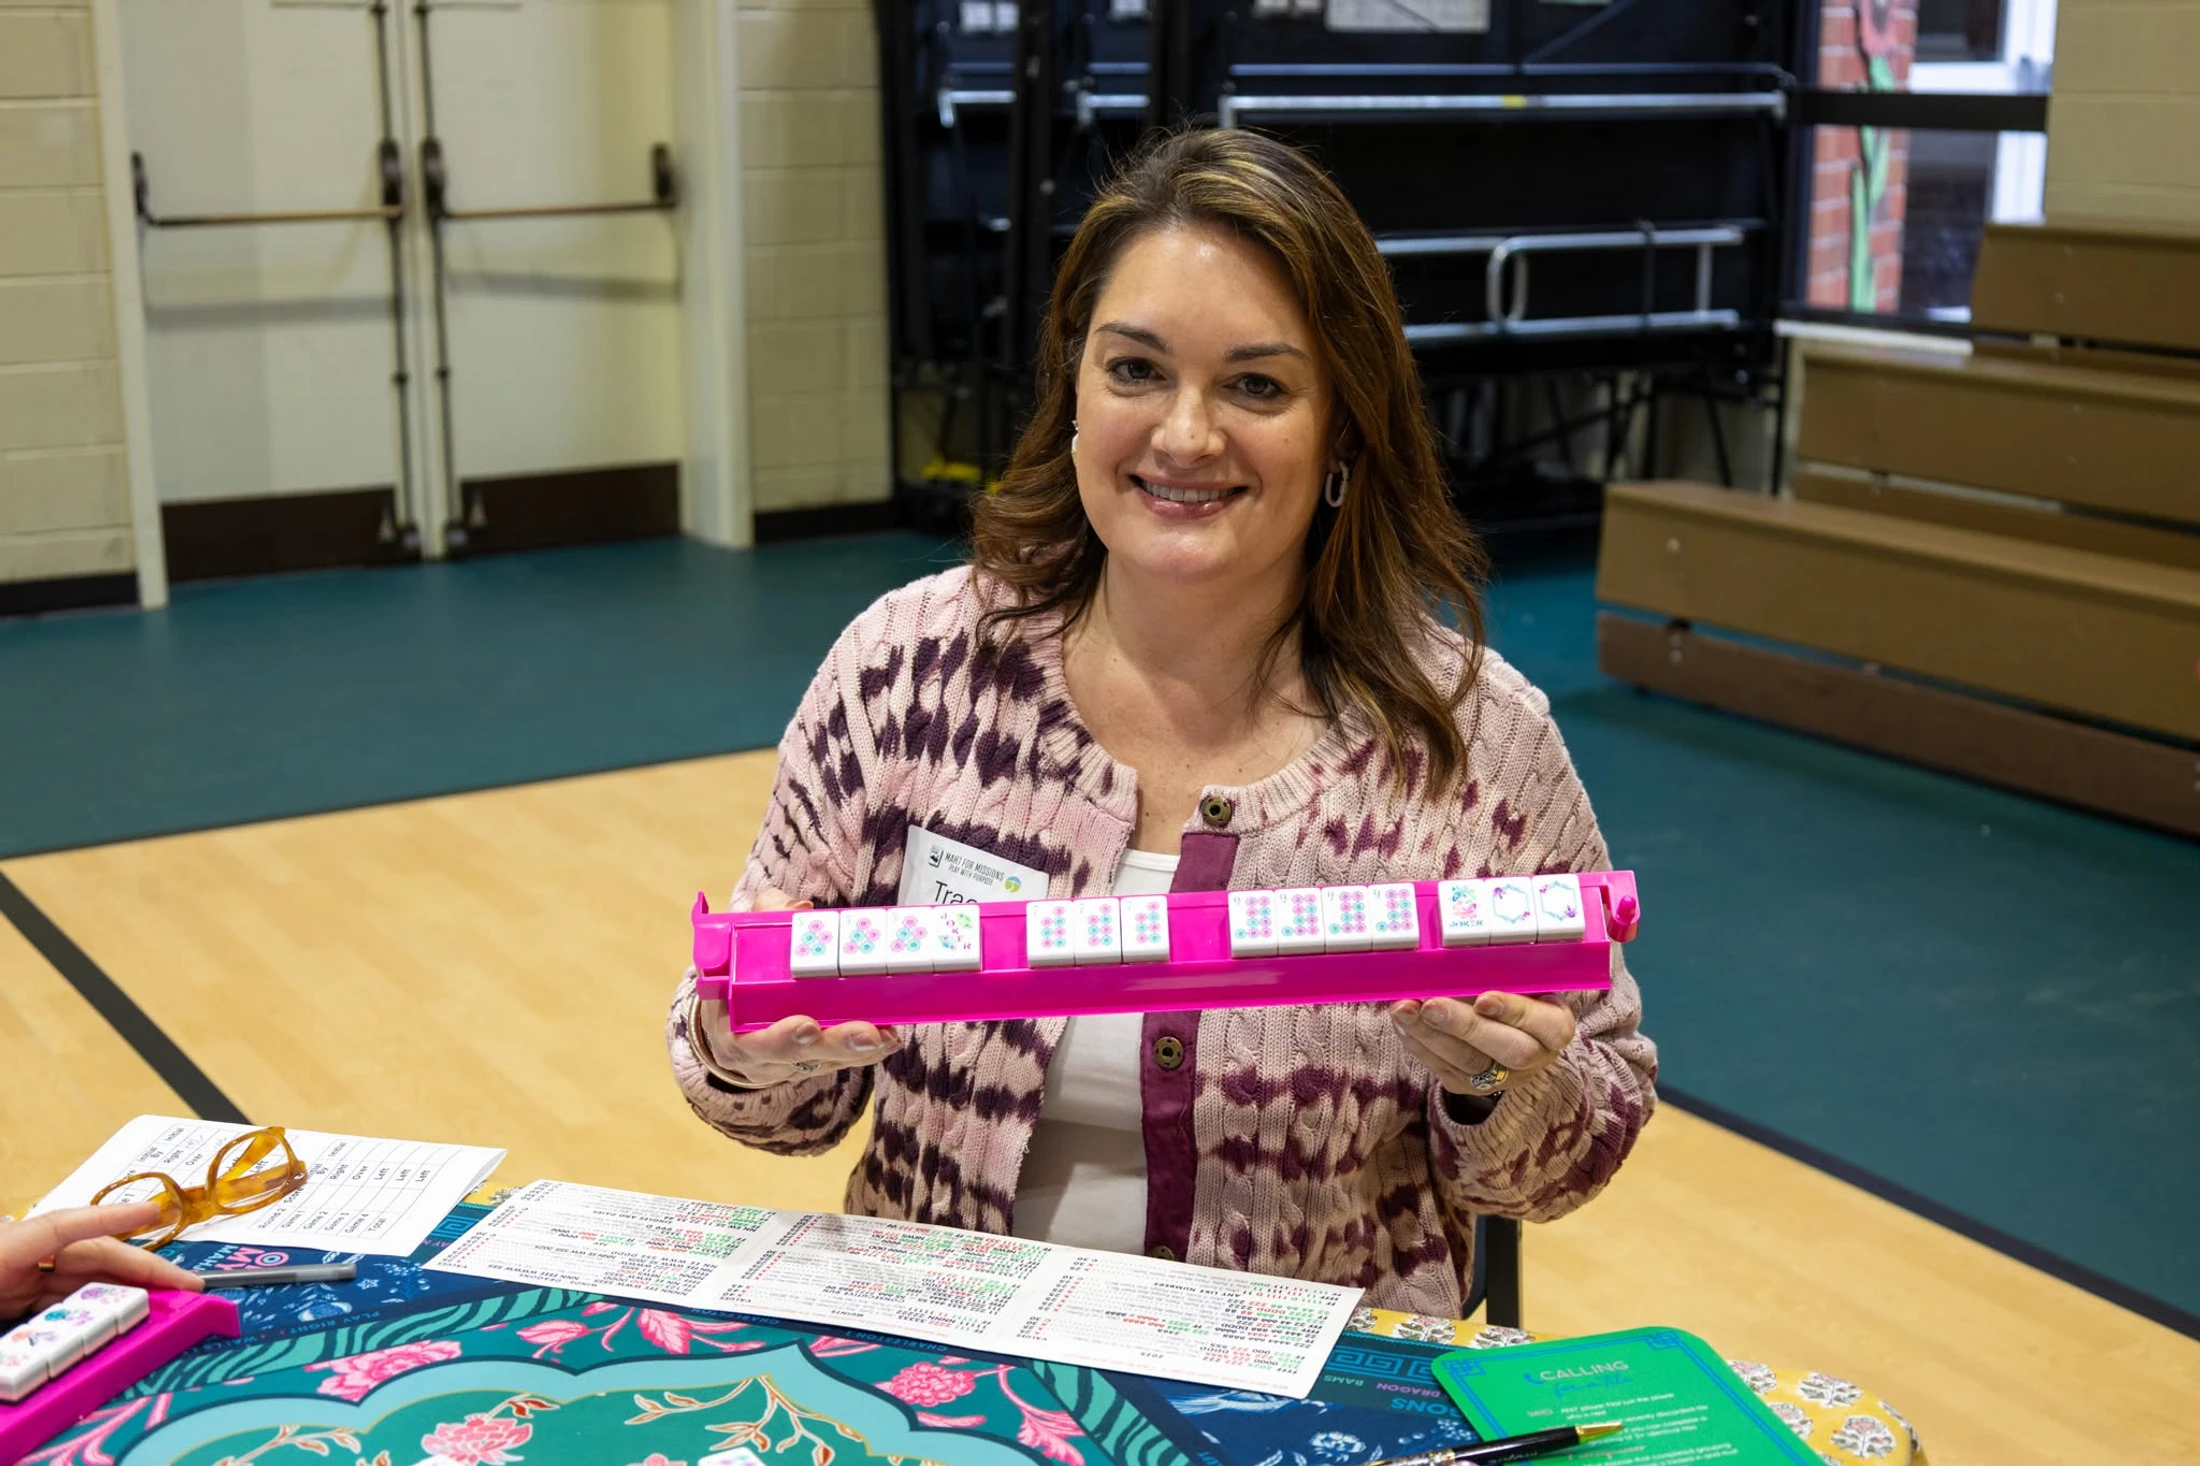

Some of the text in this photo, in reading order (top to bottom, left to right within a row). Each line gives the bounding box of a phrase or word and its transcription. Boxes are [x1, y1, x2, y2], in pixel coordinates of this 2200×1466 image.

[945, 852, 1006, 883] MAHJ FOR MISSIONS
[948, 864, 994, 887] PLAY WITH PURPOSE
[163, 1149, 185, 1164] Right
[185, 1153, 203, 1166] Over
[329, 1163, 349, 1180] Right
[352, 1164, 369, 1181] Over
[373, 1167, 390, 1180] Left
[396, 1169, 411, 1182] Left
[414, 1169, 431, 1182] Left
[281, 1213, 299, 1229] Game
[303, 1214, 322, 1230] Game
[324, 1215, 344, 1232] Game
[344, 1217, 364, 1233] Game
[367, 1218, 387, 1232] Total
[518, 1273, 563, 1282] DRAGONS
[1152, 1282, 1197, 1291] NUMBERS
[719, 1296, 752, 1304] VALUES
[842, 1291, 906, 1304] CONSECUTIVE
[830, 1310, 864, 1318] QUINTS
[290, 1311, 380, 1334] PLAY RIGHT
[854, 1332, 948, 1352] CHARLESTON
[1015, 1333, 1048, 1341] VALUES
[1540, 1360, 1629, 1381] CALLING
[1323, 1375, 1365, 1387] BAMS
[1376, 1382, 1441, 1398] DRAGON
